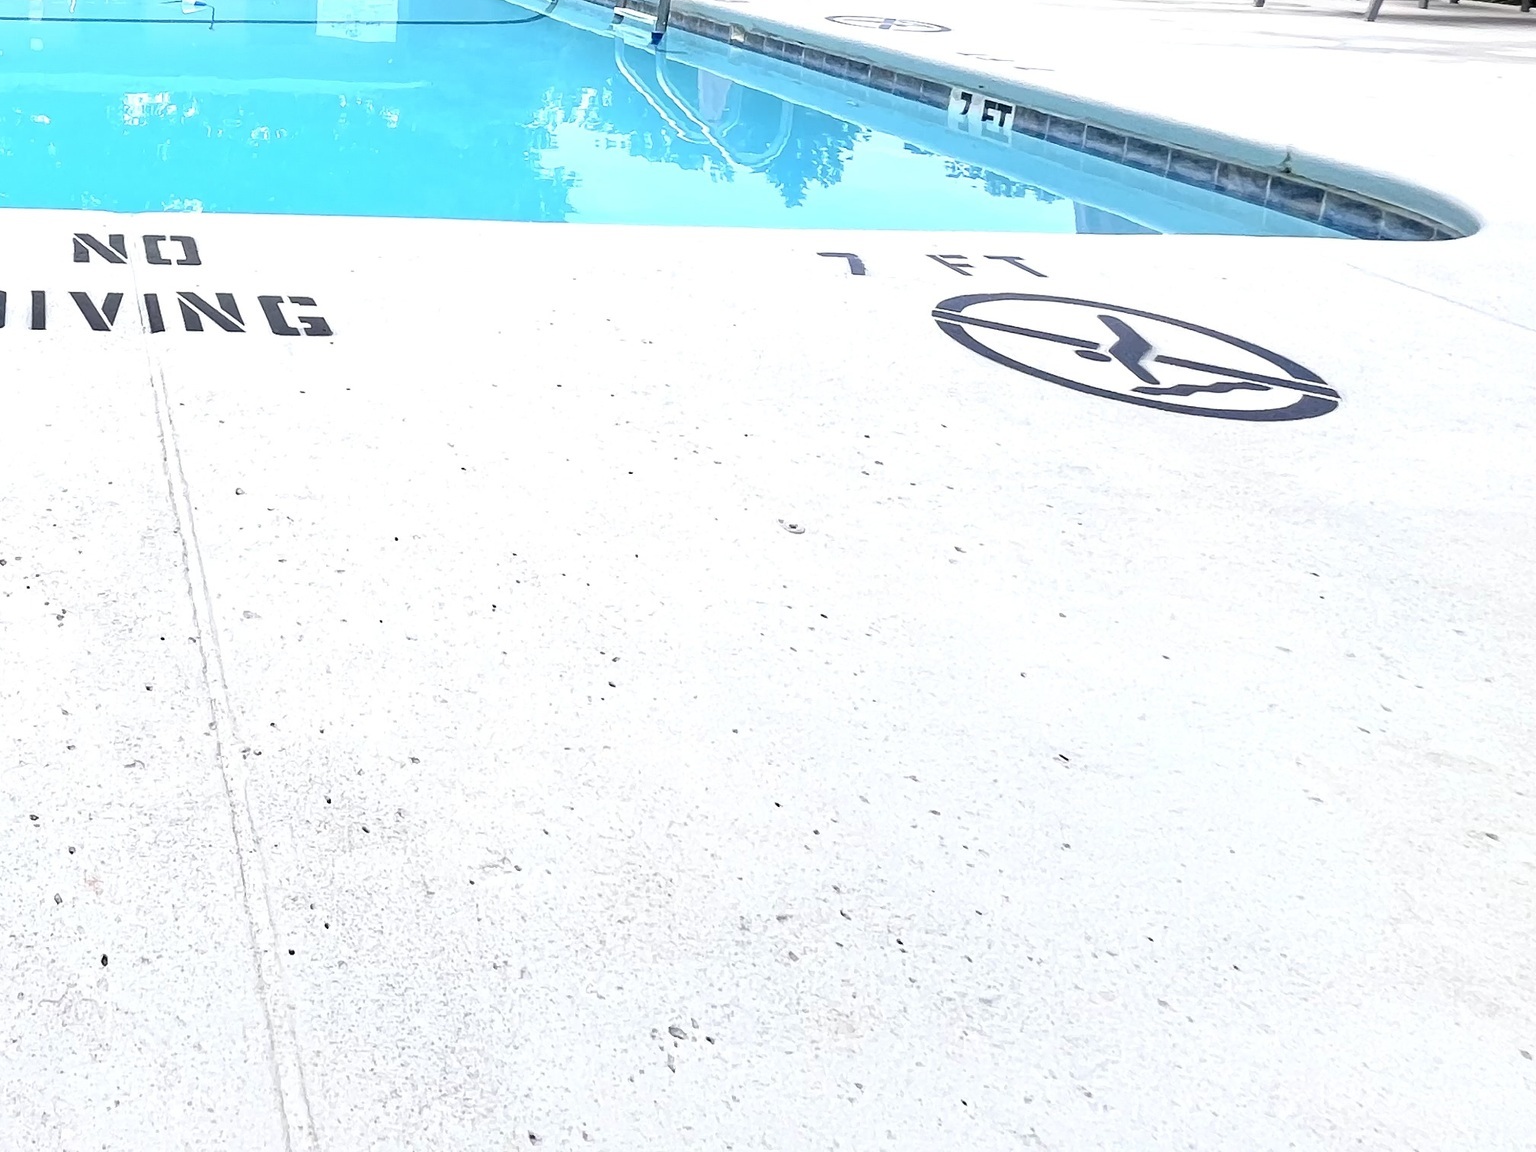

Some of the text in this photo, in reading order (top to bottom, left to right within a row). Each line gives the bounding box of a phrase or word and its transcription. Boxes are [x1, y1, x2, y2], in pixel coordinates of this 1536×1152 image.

[959, 91, 1013, 128] 7 FT
[72, 233, 202, 265] NO
[816, 251, 1049, 278] 7 FT
